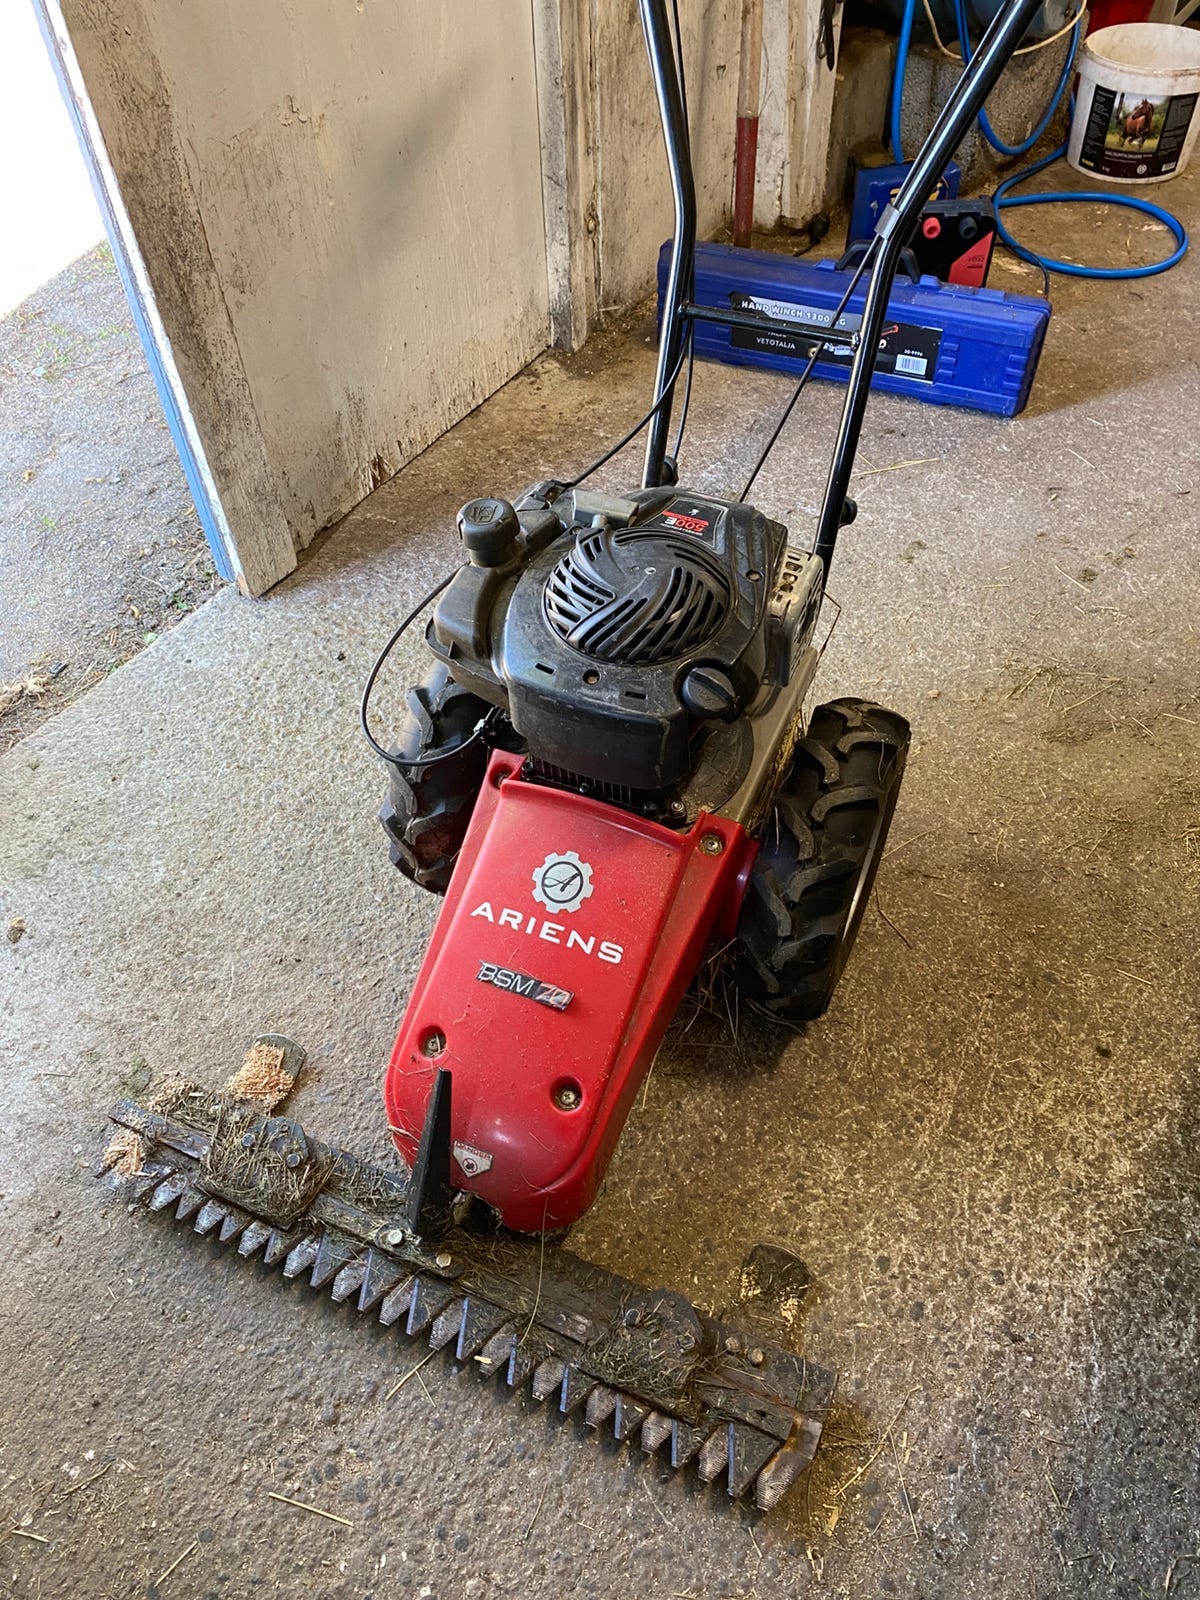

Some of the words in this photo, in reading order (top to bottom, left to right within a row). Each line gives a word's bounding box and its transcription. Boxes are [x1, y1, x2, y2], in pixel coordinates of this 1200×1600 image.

[741, 300, 770, 311] HAND
[771, 304, 804, 317] WINCH
[806, 313, 830, 323] 1300
[756, 336, 796, 350] VETOTALJA
[664, 516, 705, 533] 500E
[470, 901, 624, 964] ARIENS
[476, 961, 535, 996] BSM
[535, 980, 571, 1008] 70
